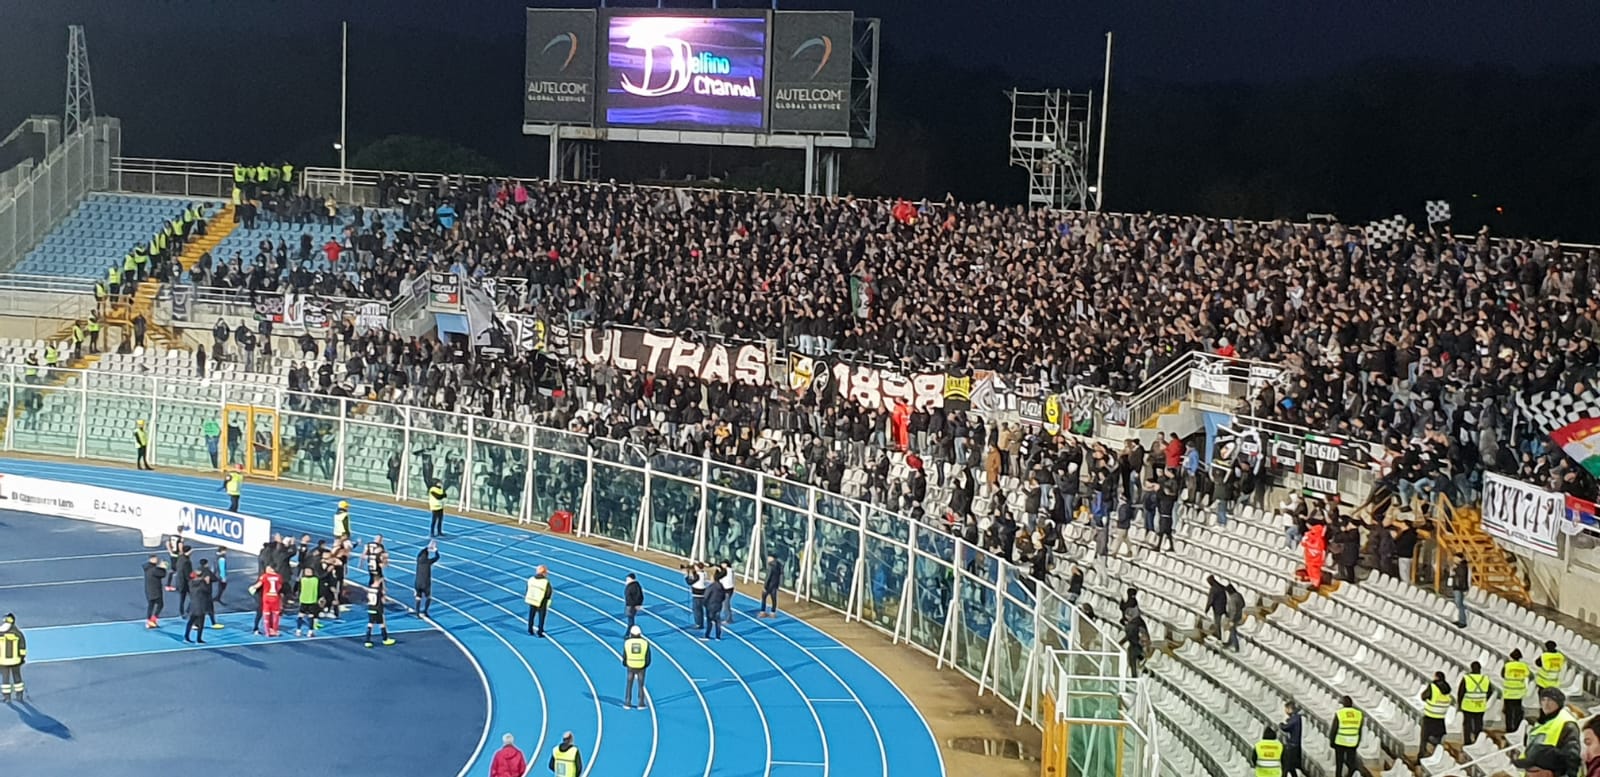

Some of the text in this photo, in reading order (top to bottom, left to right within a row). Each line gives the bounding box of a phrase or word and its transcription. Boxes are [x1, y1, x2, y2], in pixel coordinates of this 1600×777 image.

[527, 81, 586, 95] AUTELCOM
[693, 75, 757, 98] Channel
[527, 94, 586, 103] GLOBAL SERVICE
[776, 89, 843, 102] AUTELCOM
[775, 102, 806, 110] GLOBAL
[585, 328, 766, 387] ULTRAS
[833, 362, 945, 415] 1898
[1315, 460, 1324, 475] V
[93, 499, 143, 517] BALZANO
[197, 513, 242, 539] MAICO
